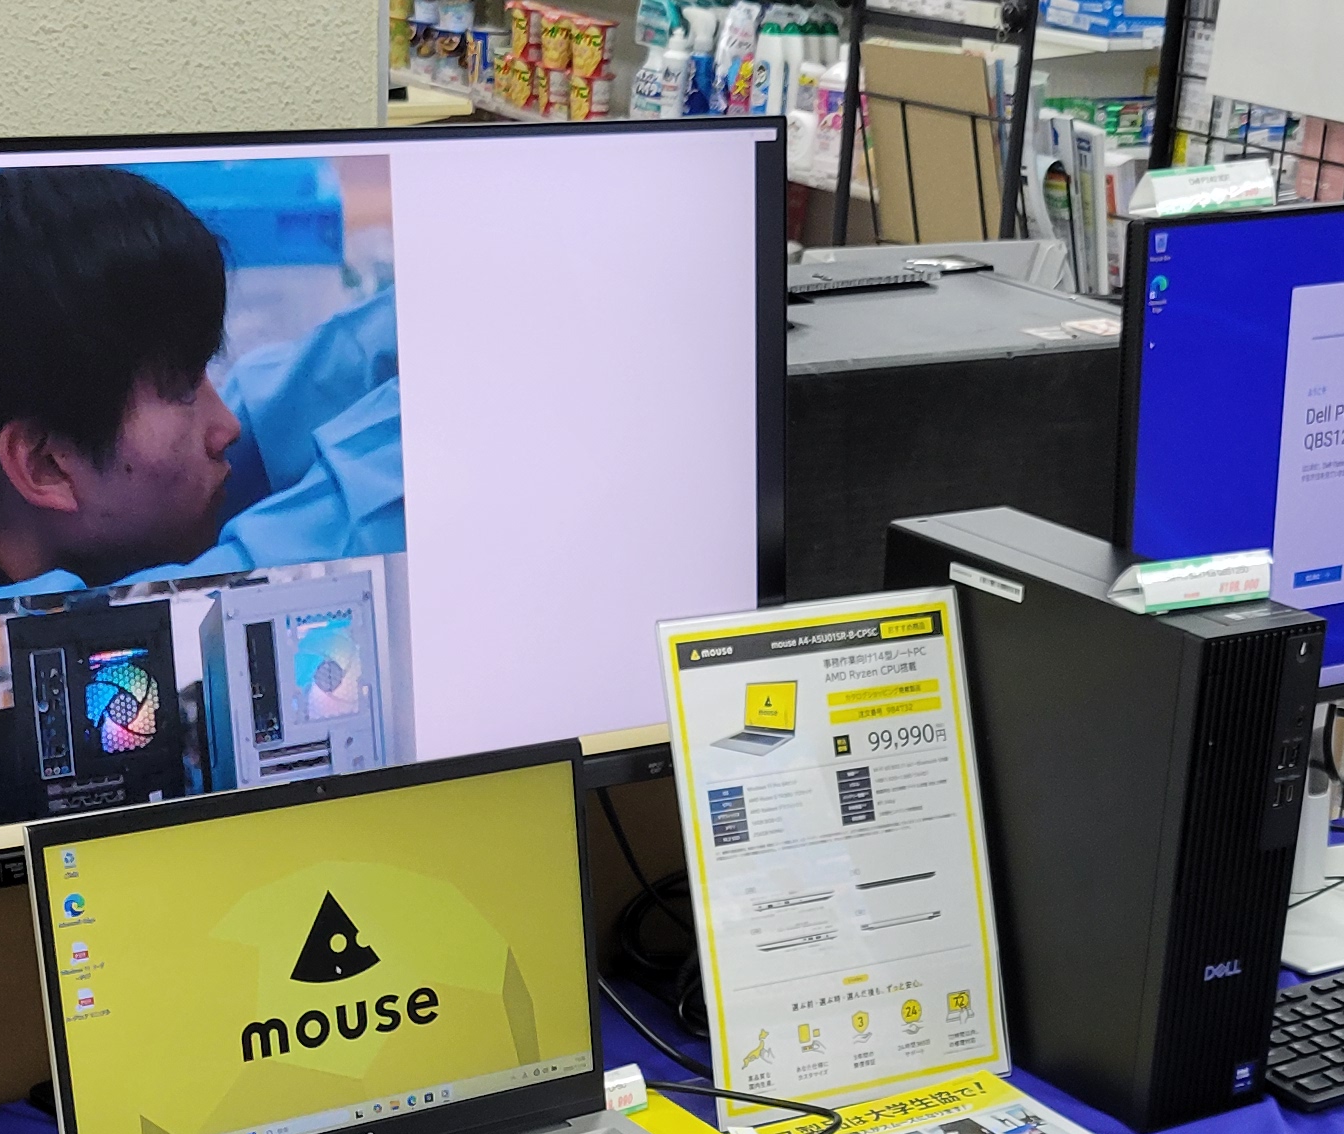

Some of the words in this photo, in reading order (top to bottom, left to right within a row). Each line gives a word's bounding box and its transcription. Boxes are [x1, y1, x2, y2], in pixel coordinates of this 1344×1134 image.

[1306, 405, 1331, 425] Dell
[887, 621, 926, 634] おすすめ商品
[771, 635, 797, 649] mouse
[701, 646, 733, 659] mouse
[823, 646, 927, 669] 事務作業向け14型ノートPC
[825, 670, 847, 683] AMD
[849, 668, 878, 681] Ryzen
[881, 662, 917, 676] CPU搭載
[867, 723, 947, 751] 99,990円
[1204, 959, 1242, 981] DELL
[857, 1015, 864, 1028] 3
[905, 1005, 918, 1018] 24
[240, 986, 440, 1064] mouse
